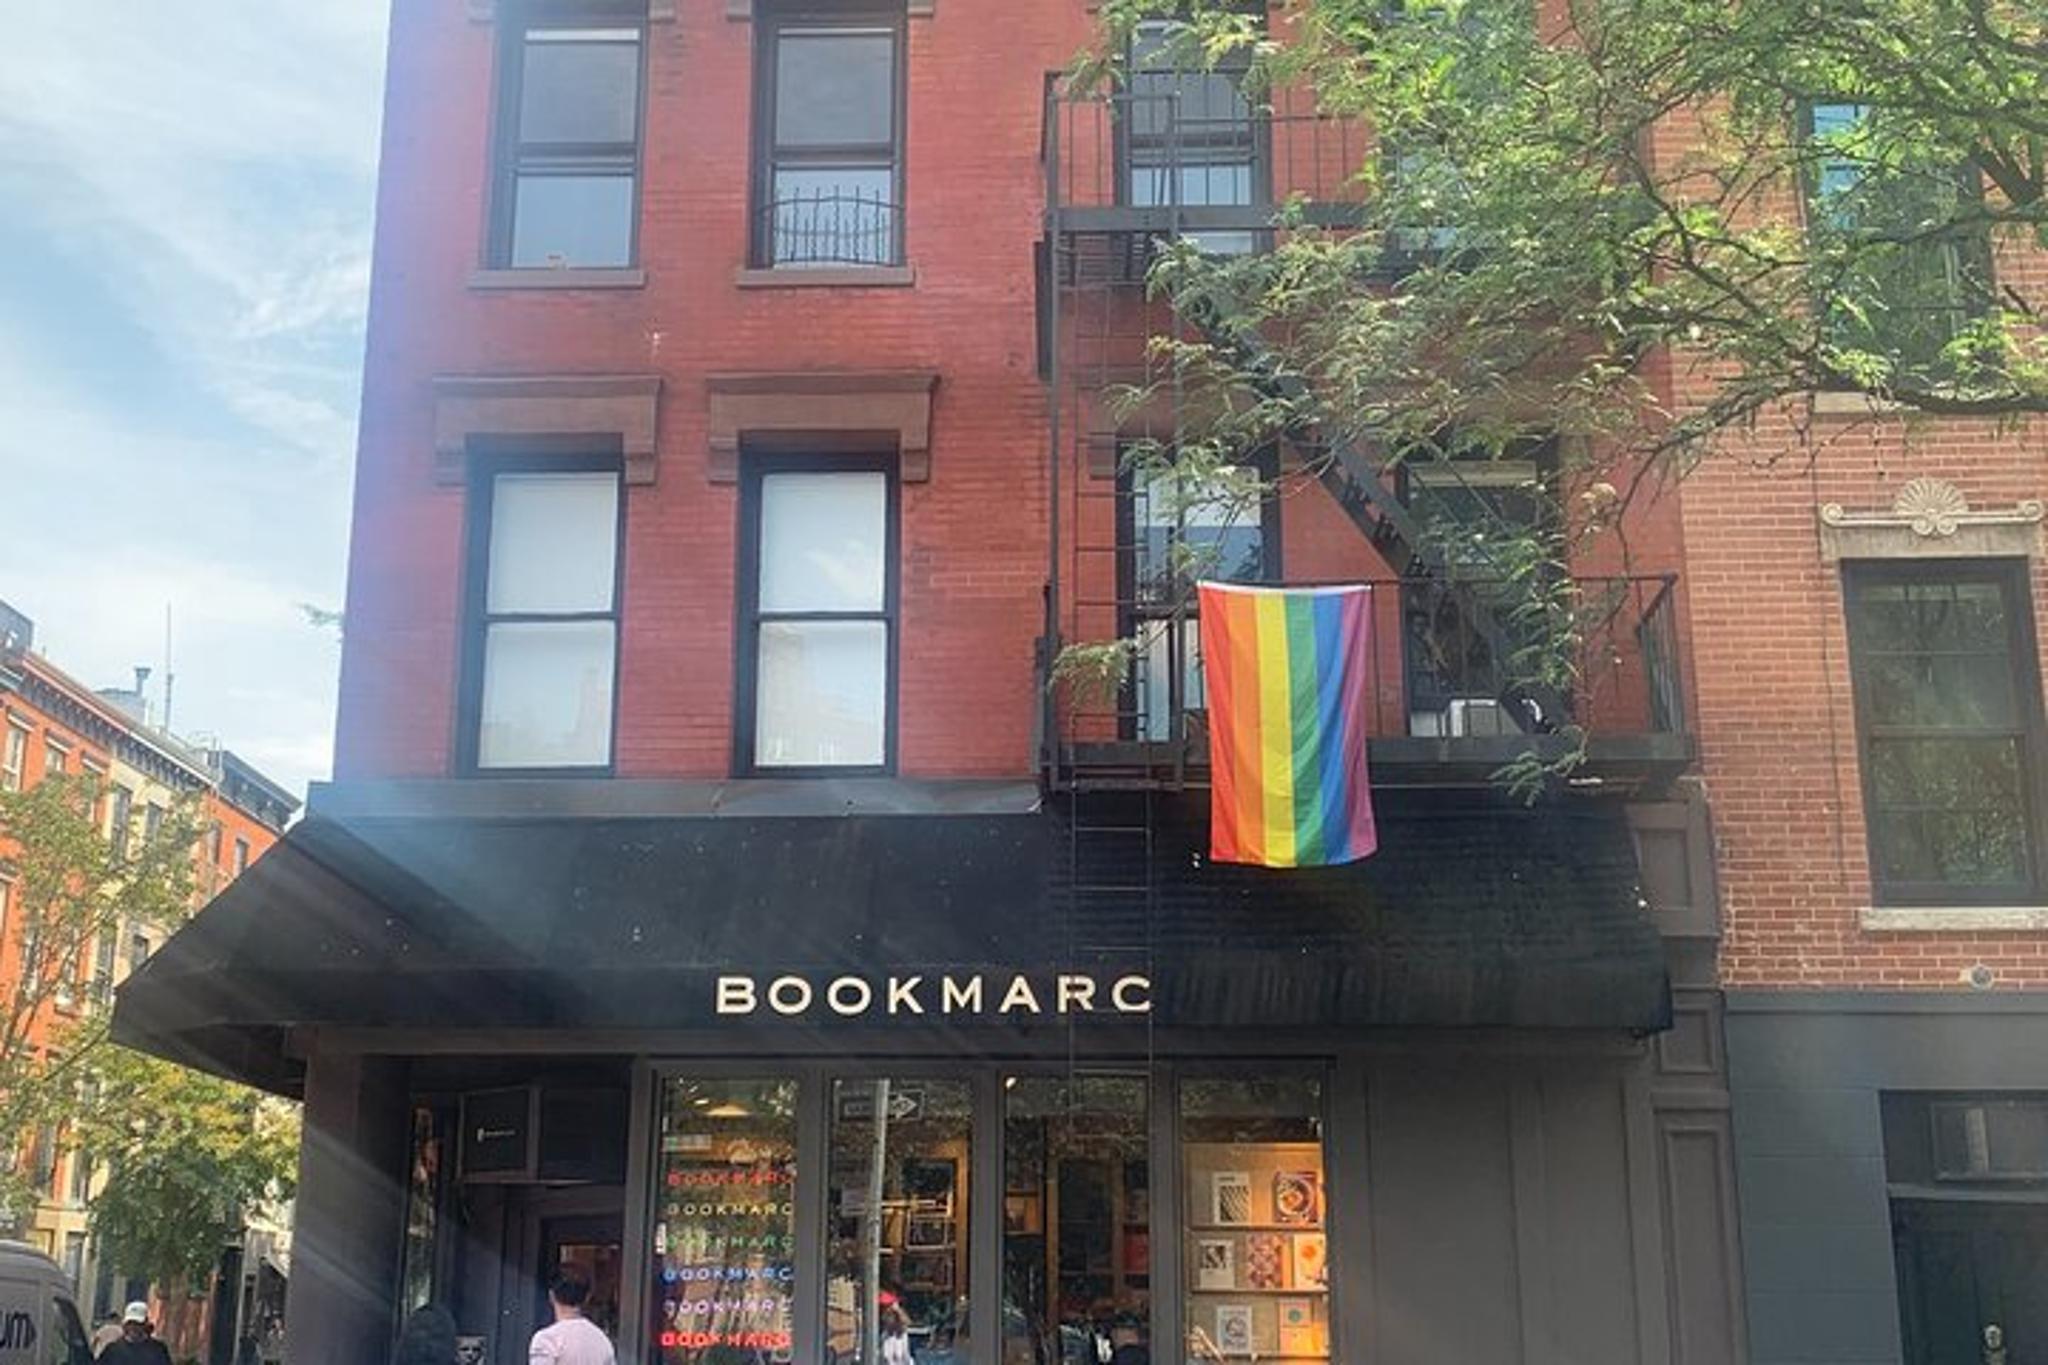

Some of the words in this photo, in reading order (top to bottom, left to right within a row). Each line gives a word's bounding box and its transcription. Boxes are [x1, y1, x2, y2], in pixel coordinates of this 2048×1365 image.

[716, 976, 1153, 1014] BOOKMARC
[668, 1203, 793, 1216] BOOKMARC
[664, 1267, 792, 1282] BOOKMARC
